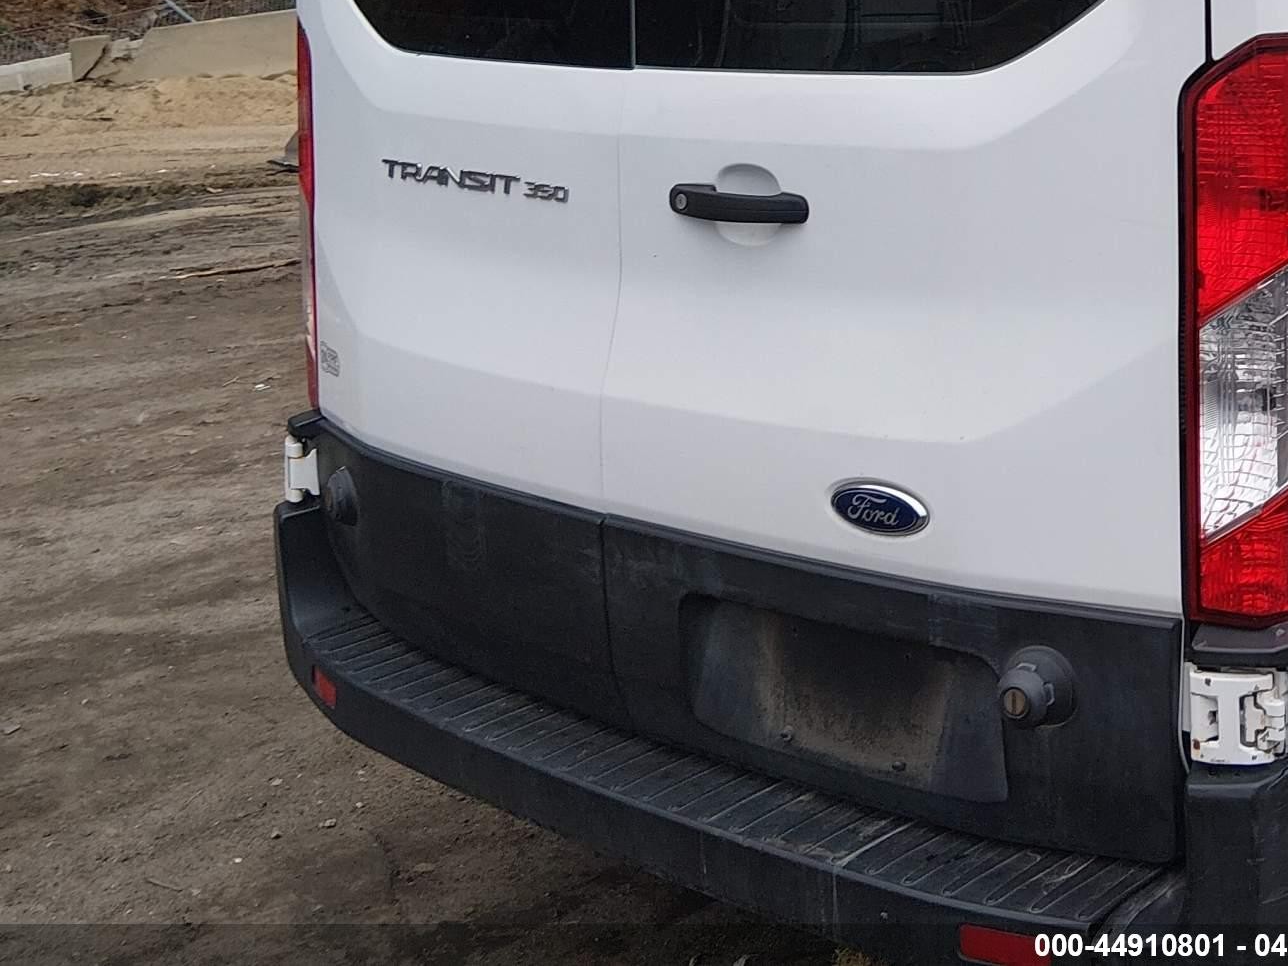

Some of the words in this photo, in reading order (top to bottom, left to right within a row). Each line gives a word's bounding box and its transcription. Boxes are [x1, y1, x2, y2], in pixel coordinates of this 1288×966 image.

[381, 158, 521, 195] TRANSIT
[523, 180, 570, 203] 350
[847, 493, 900, 526] Ford
